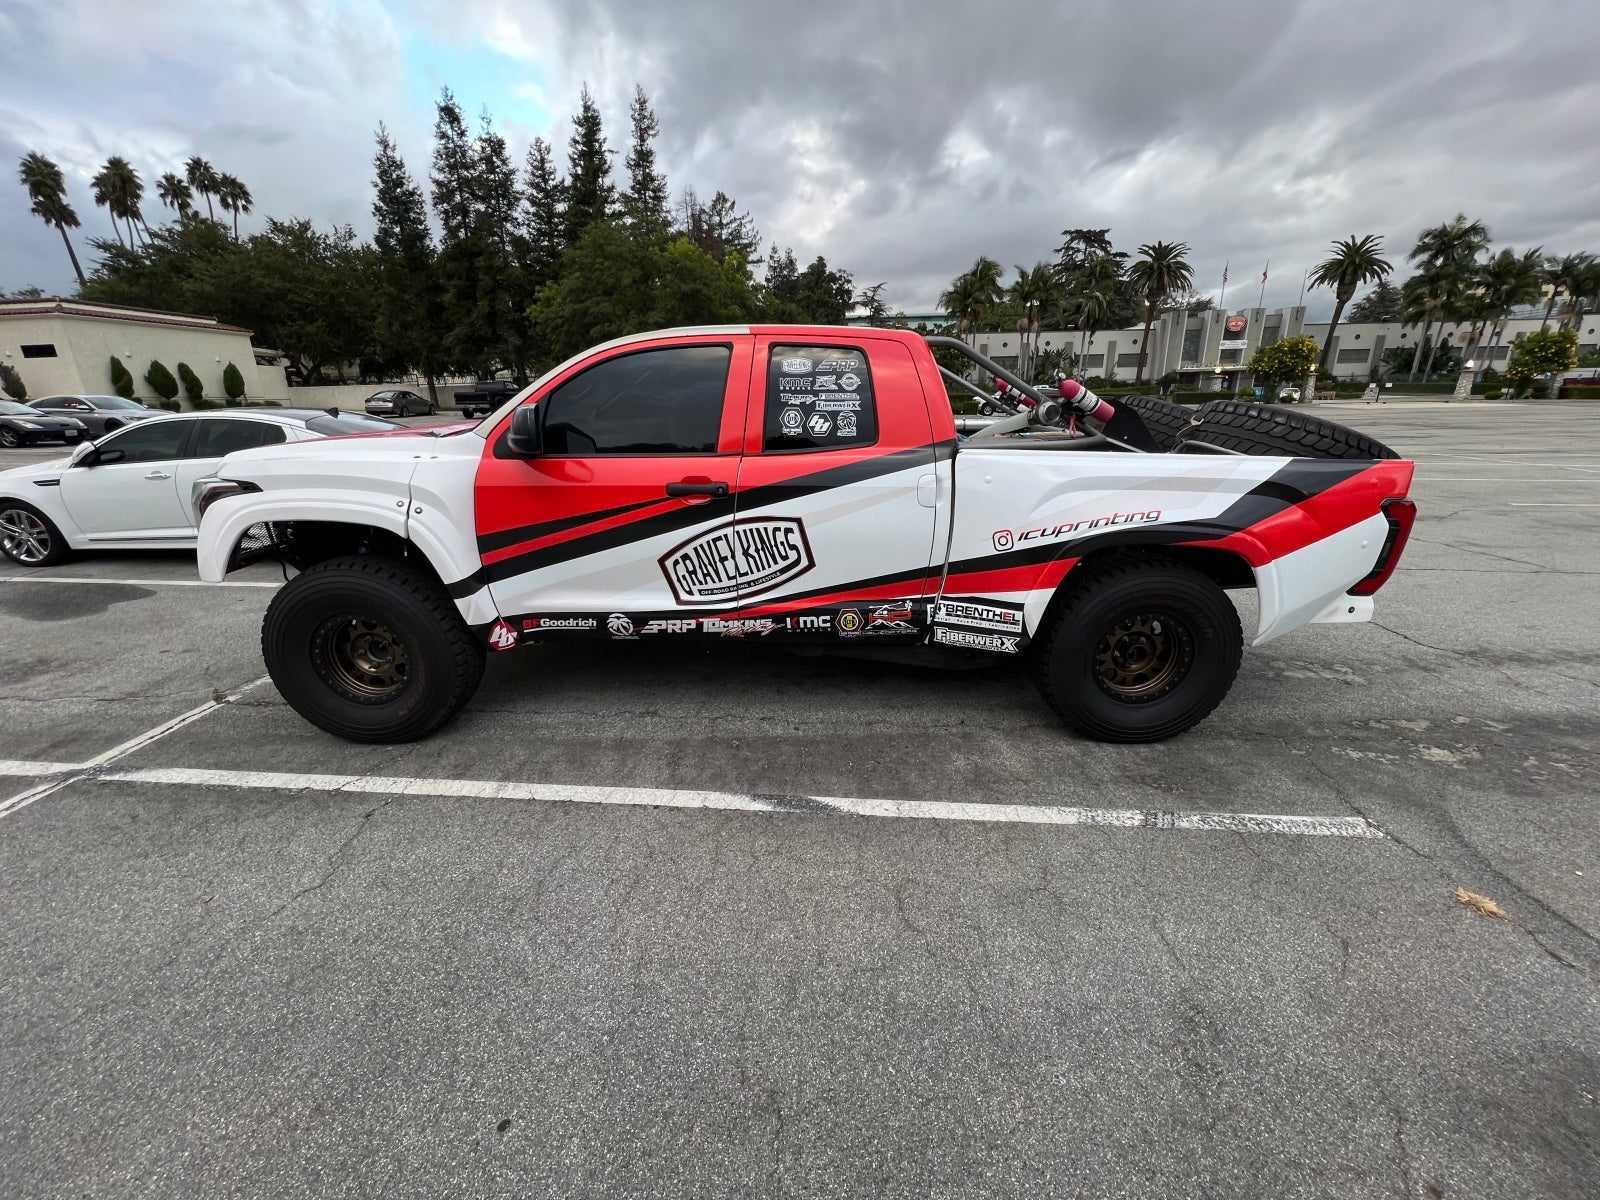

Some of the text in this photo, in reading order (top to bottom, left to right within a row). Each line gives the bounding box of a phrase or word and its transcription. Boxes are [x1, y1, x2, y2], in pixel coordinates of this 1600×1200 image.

[945, 603, 1021, 623] BRENTHEL
[522, 618, 597, 629] BFGoodrich
[641, 619, 697, 634] PRP
[699, 618, 773, 633] TOMKINS
[936, 628, 1016, 651] FIBERWERX
